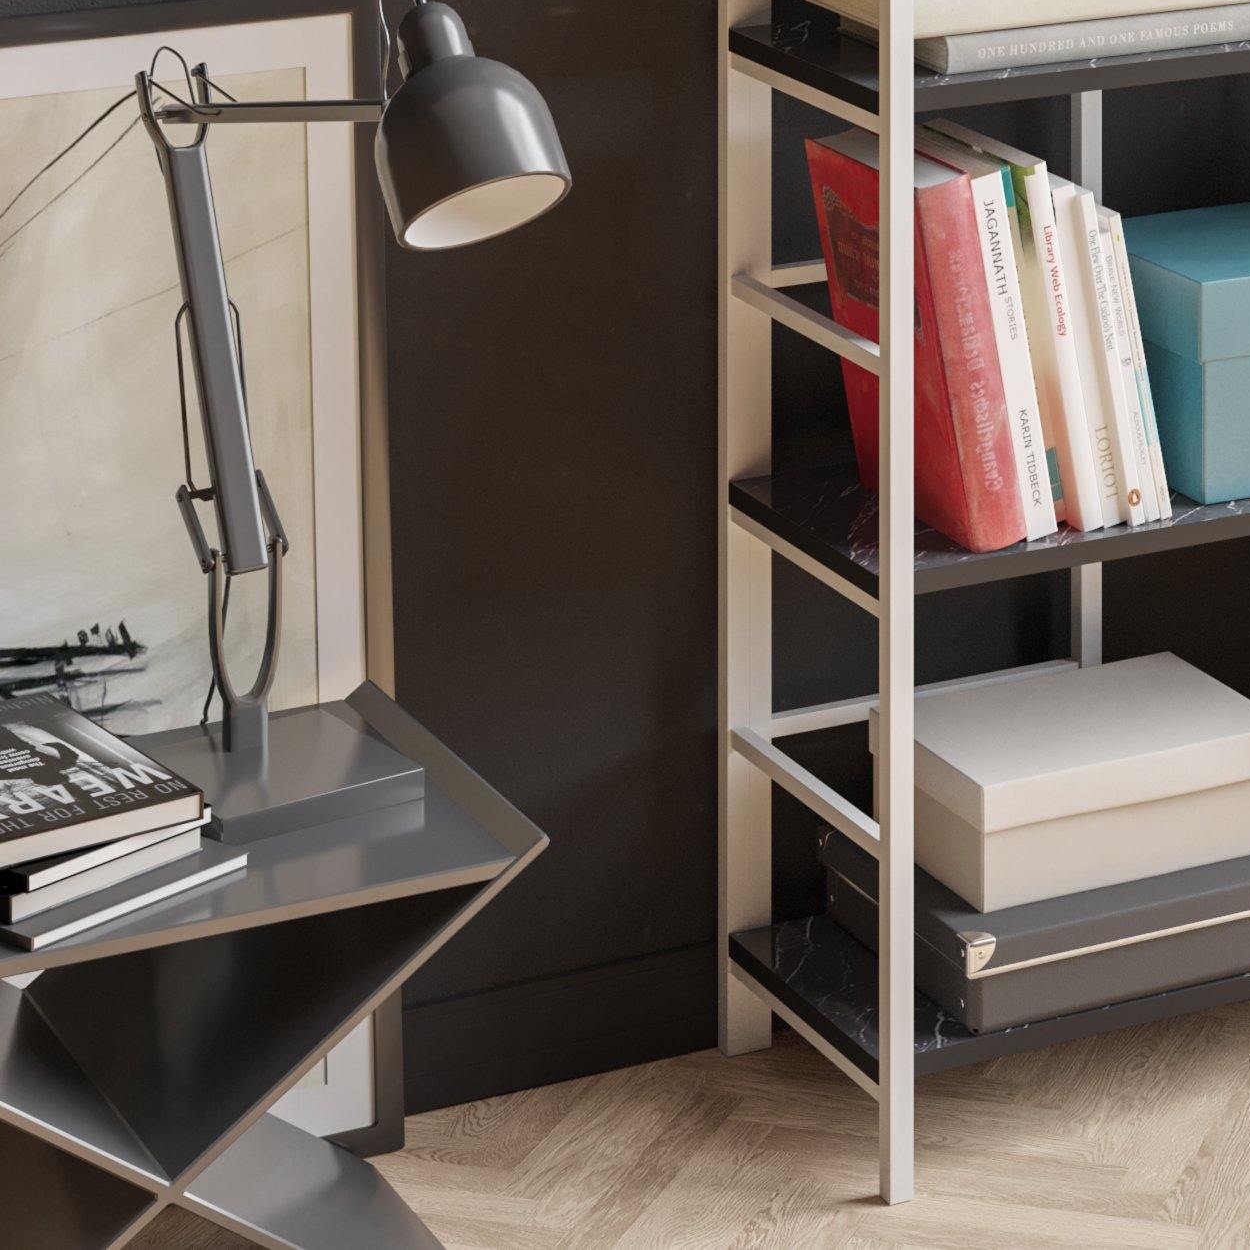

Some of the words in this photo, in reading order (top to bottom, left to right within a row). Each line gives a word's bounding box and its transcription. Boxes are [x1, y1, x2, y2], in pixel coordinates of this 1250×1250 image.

[978, 46, 1005, 58] ONE
[1009, 39, 1074, 56] HUNDRED
[1079, 35, 1106, 48] AND
[1109, 32, 1136, 45] ONE
[1140, 25, 1190, 41] FAMOUS
[1193, 20, 1235, 35] POEMS
[1043, 225, 1055, 264] Library
[1088, 229, 1097, 247] One
[984, 199, 1008, 296] JAGANNATH
[1004, 296, 1018, 341] STORIES
[1050, 266, 1062, 292] Web
[1094, 265, 1104, 285] Over
[1097, 285, 1108, 298] The
[1055, 294, 1068, 336] Ecology
[1019, 408, 1032, 449] KARIN
[1026, 453, 1042, 507] TIDBECK
[1094, 423, 1119, 499] LORIOT
[97, 789, 149, 810] REST
[154, 779, 187, 794] NO
[39, 804, 86, 822] FOR
